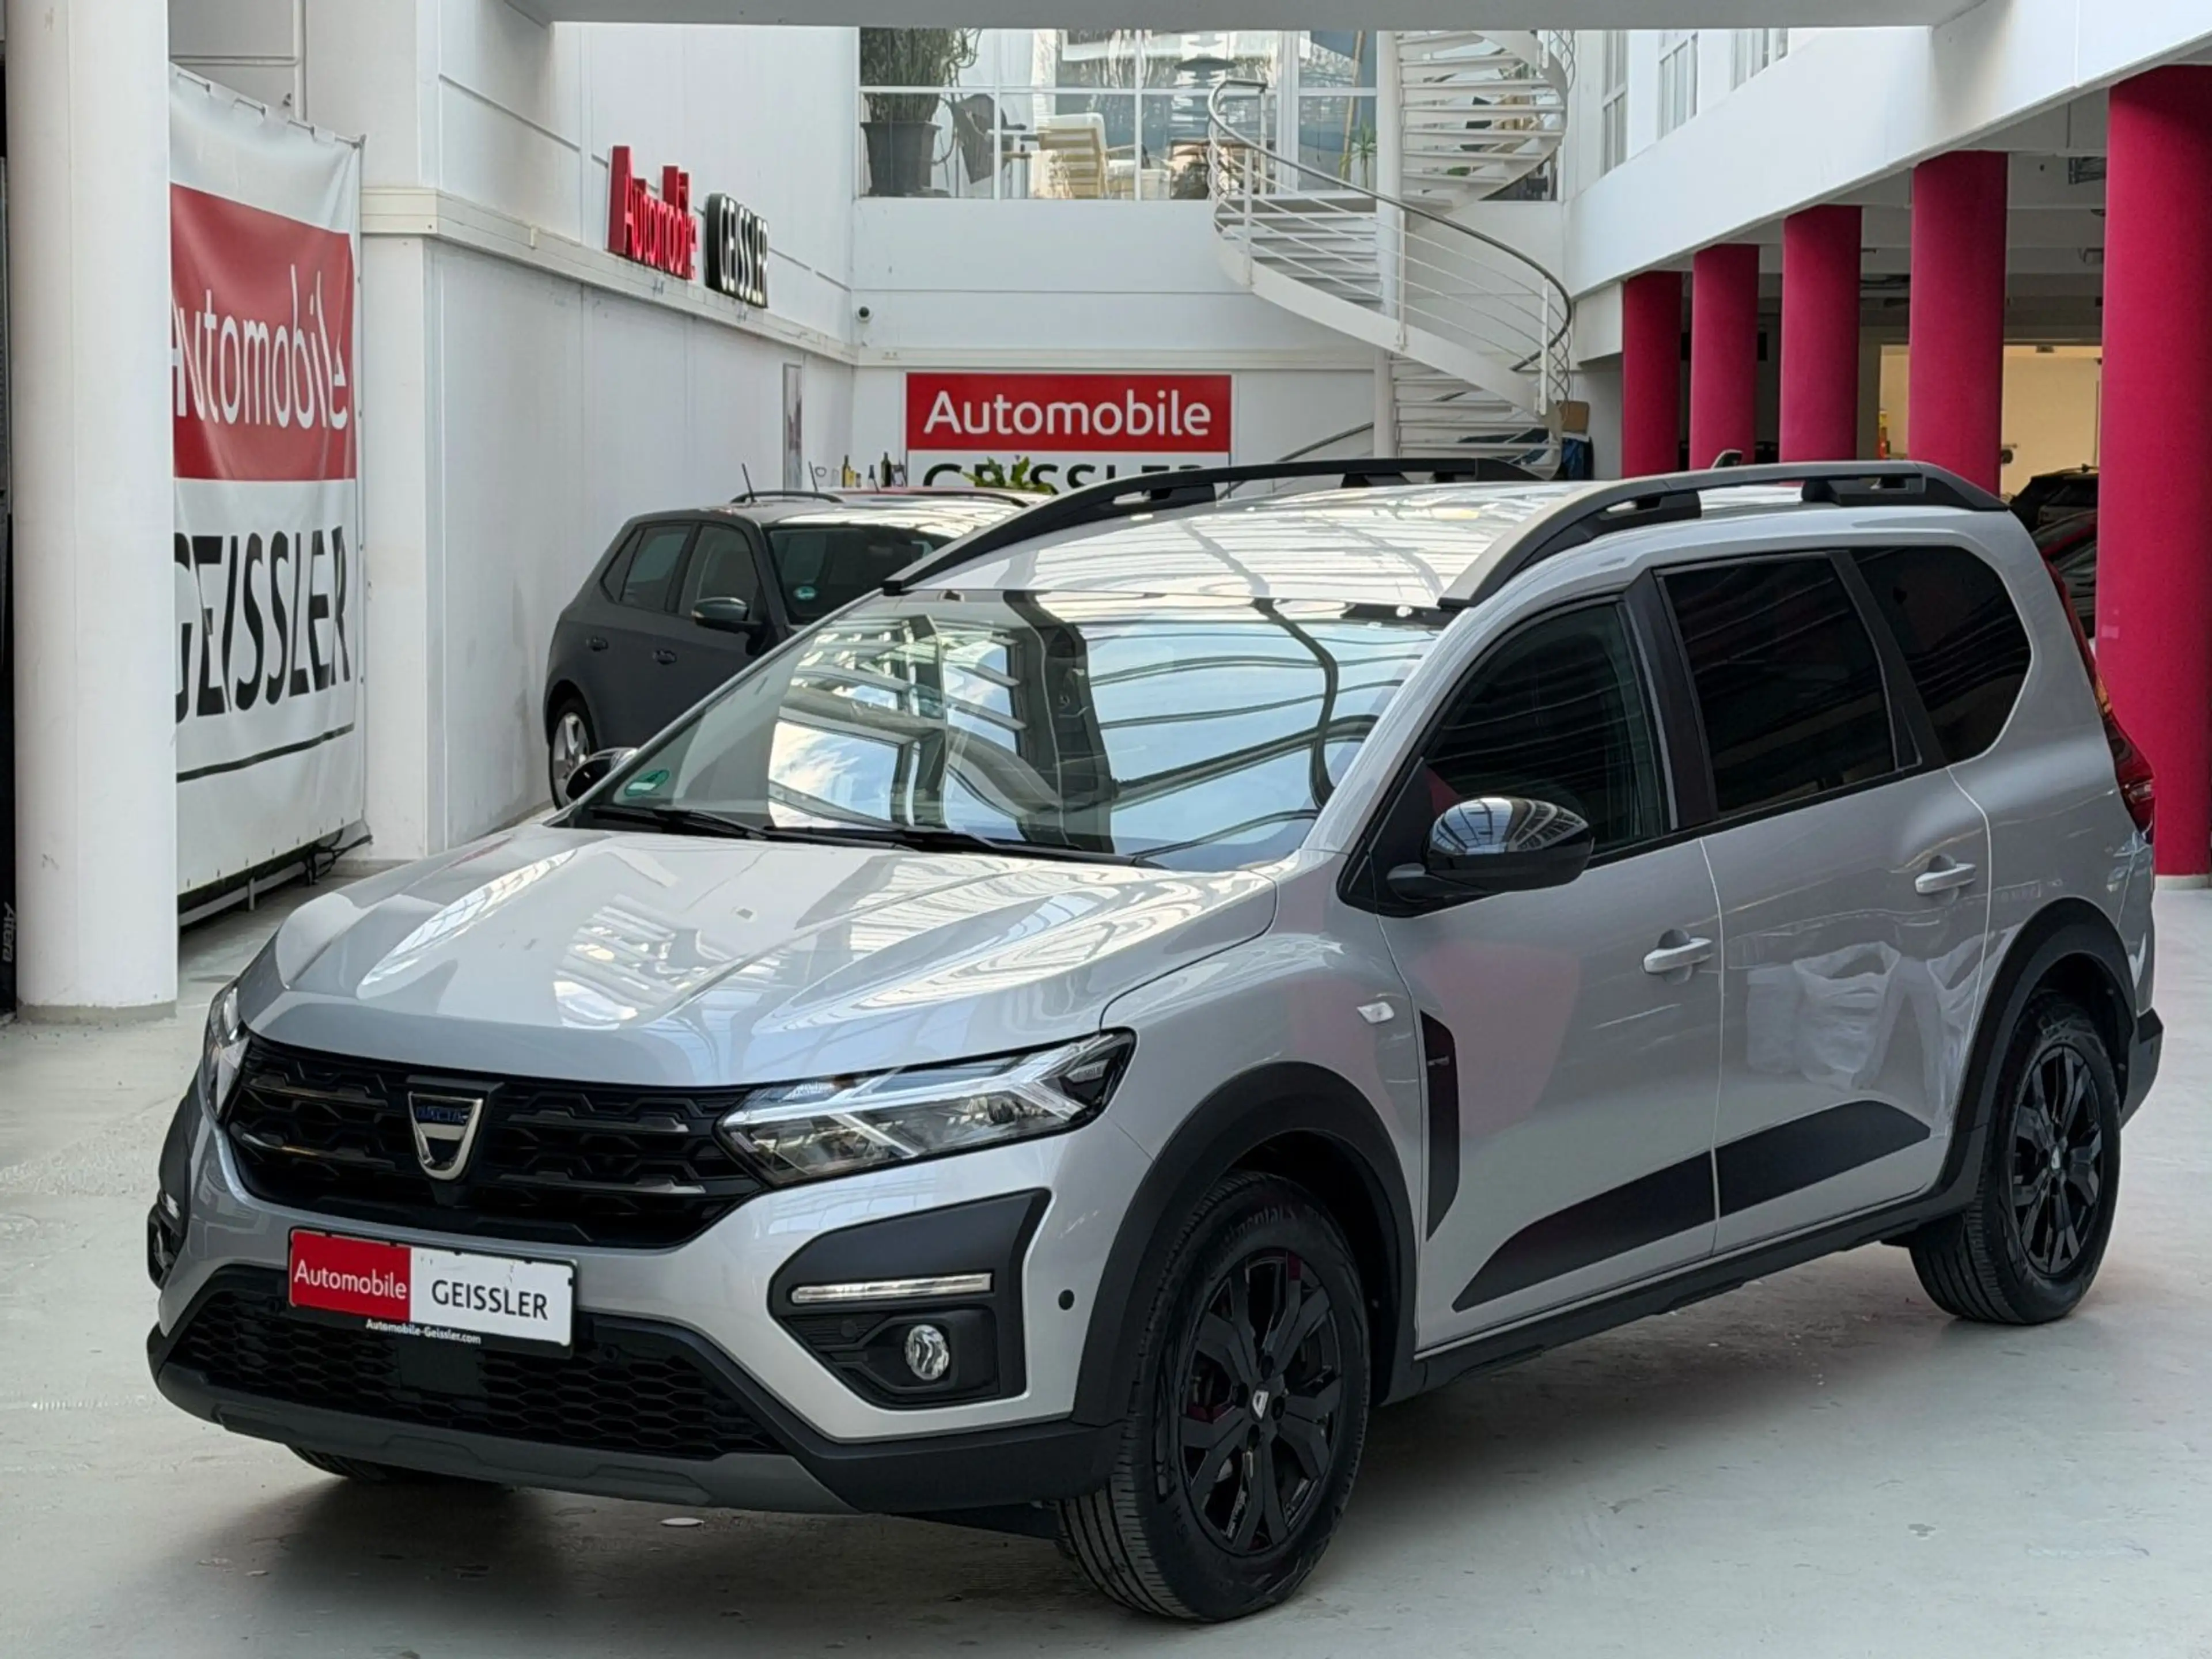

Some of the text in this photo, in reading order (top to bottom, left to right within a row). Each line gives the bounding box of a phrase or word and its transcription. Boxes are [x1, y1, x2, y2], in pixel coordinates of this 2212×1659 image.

[705, 193, 769, 308] GEISSLER
[923, 389, 1211, 436] Automobile
[294, 1259, 548, 1320] Automobile GEISSLER
[365, 1319, 482, 1345] Automobile-Geissler.com
